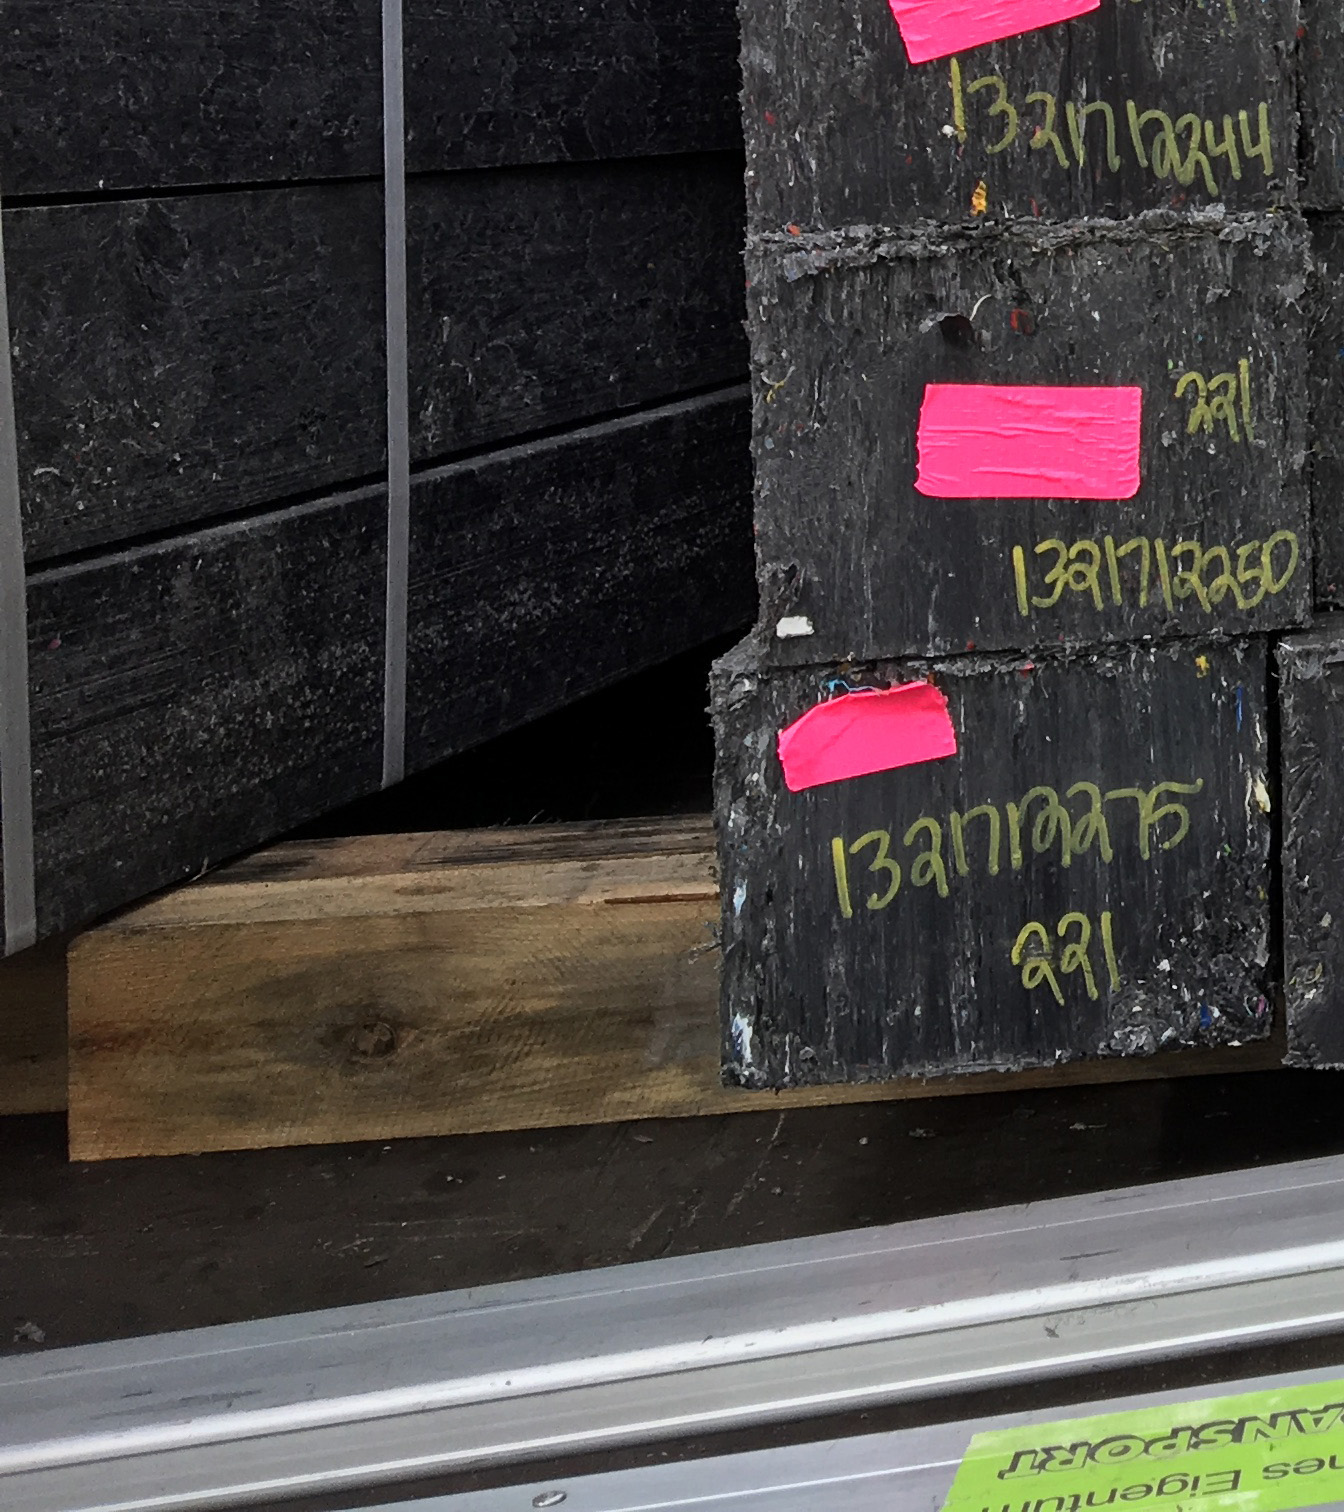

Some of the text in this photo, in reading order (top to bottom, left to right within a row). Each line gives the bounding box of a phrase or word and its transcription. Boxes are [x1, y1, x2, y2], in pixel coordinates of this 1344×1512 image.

[950, 57, 1274, 197] 1321712244
[1175, 358, 1254, 444] 221
[1012, 530, 1299, 617] 1321712250
[831, 777, 1204, 919] 1321712275
[1010, 911, 1122, 1007] 221
